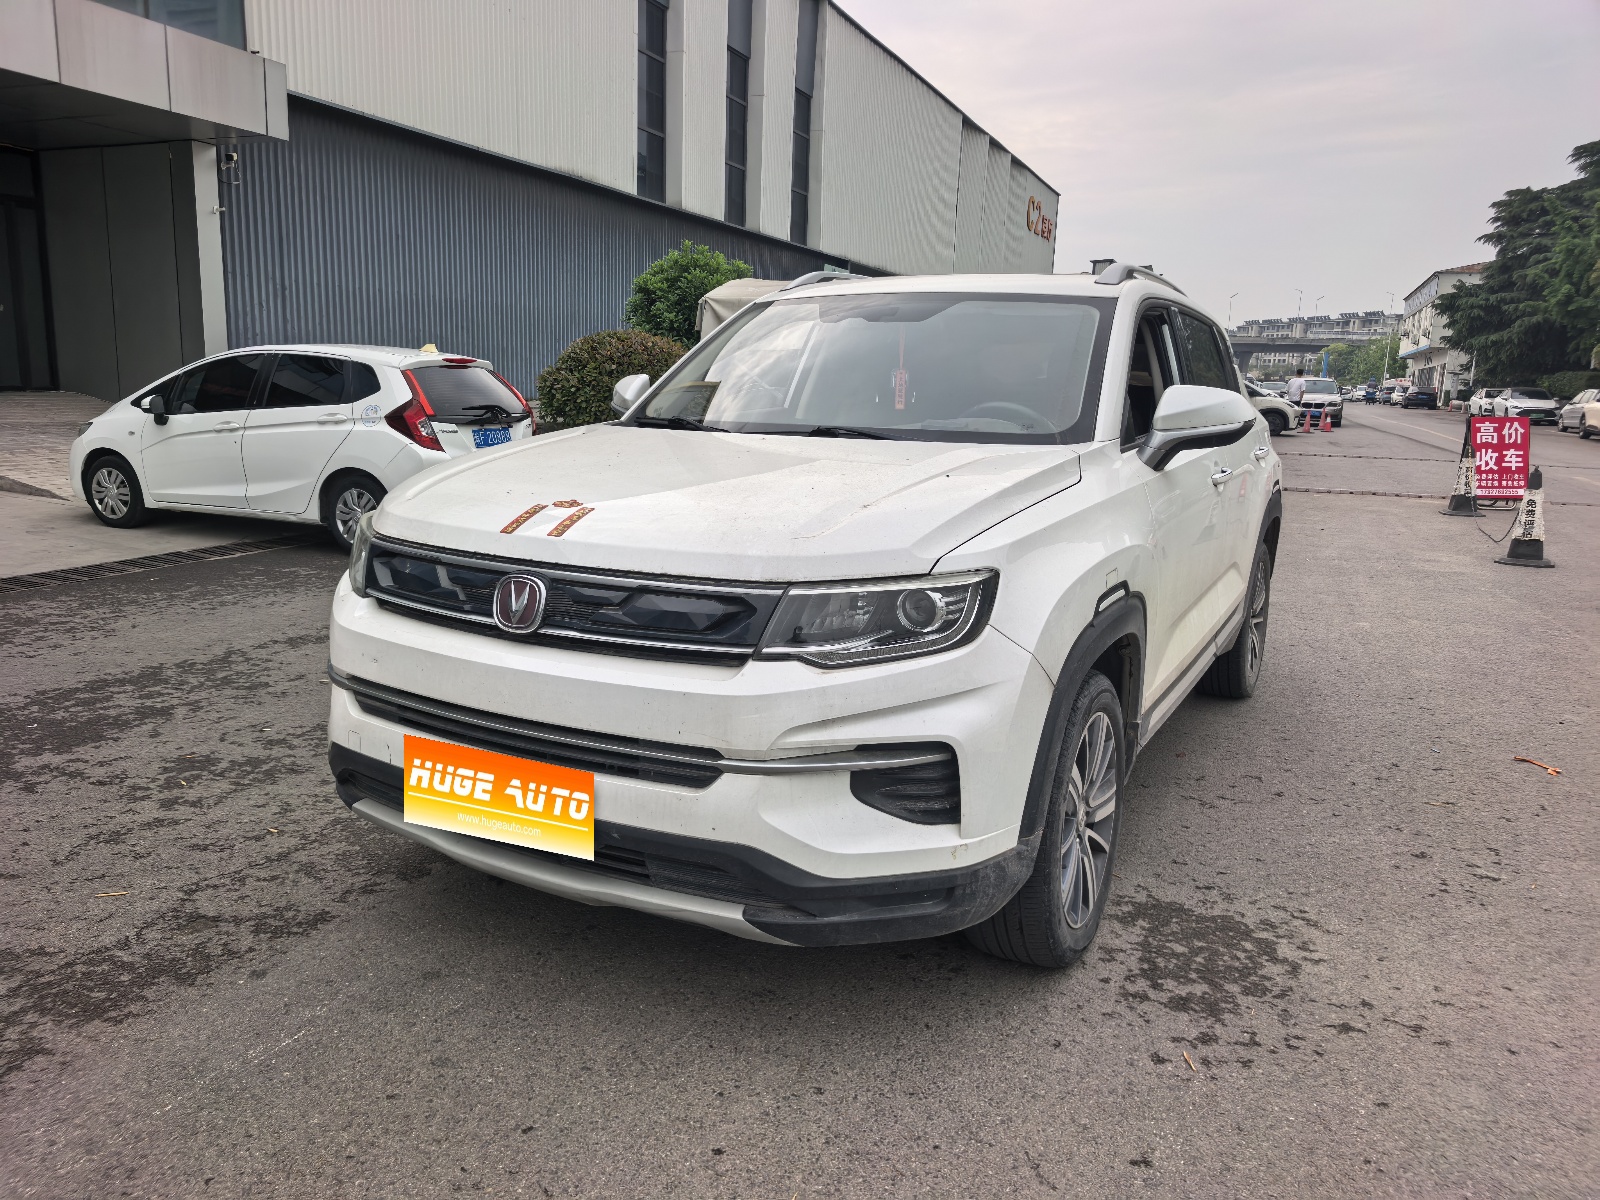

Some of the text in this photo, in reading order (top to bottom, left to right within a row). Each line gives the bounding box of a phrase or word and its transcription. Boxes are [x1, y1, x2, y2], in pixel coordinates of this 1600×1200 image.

[1475, 421, 1525, 444] 高价
[1475, 448, 1524, 471] 收车
[1522, 499, 1537, 538] 免费评估
